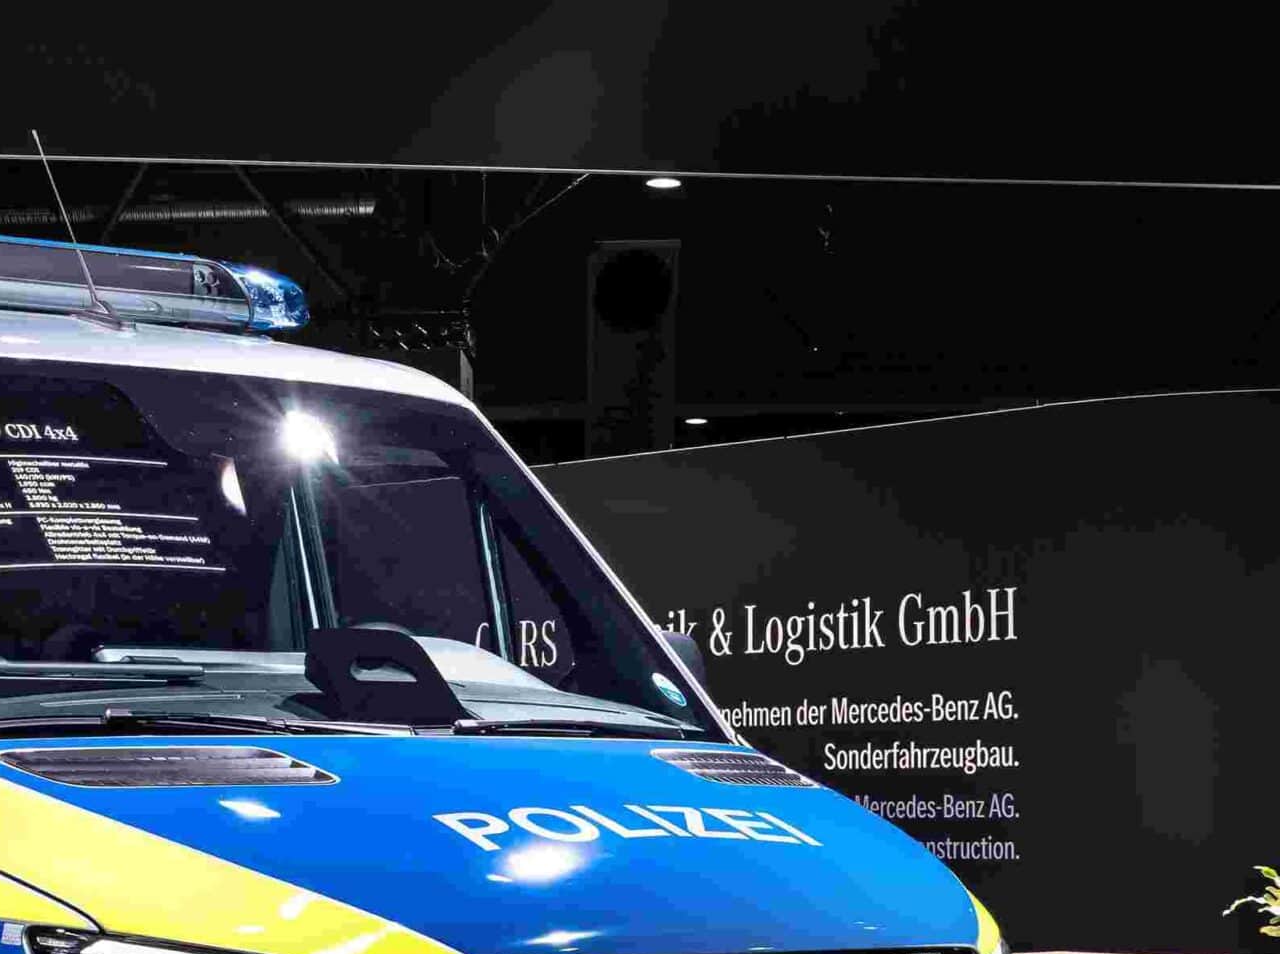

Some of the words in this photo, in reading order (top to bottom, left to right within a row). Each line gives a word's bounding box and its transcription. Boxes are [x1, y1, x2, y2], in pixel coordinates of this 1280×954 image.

[5, 423, 42, 439] CDI
[44, 425, 79, 441] 4x4
[709, 608, 733, 656] &
[744, 597, 885, 665] Logistik
[898, 587, 1018, 646] GmbH
[796, 699, 827, 726] der
[831, 694, 979, 725] Mercedes-Benz
[983, 691, 1019, 721] AG.
[823, 739, 1020, 775] Sonderfahrzeugbau.
[989, 793, 1020, 818] AG.
[431, 804, 824, 852] POLIZEI
